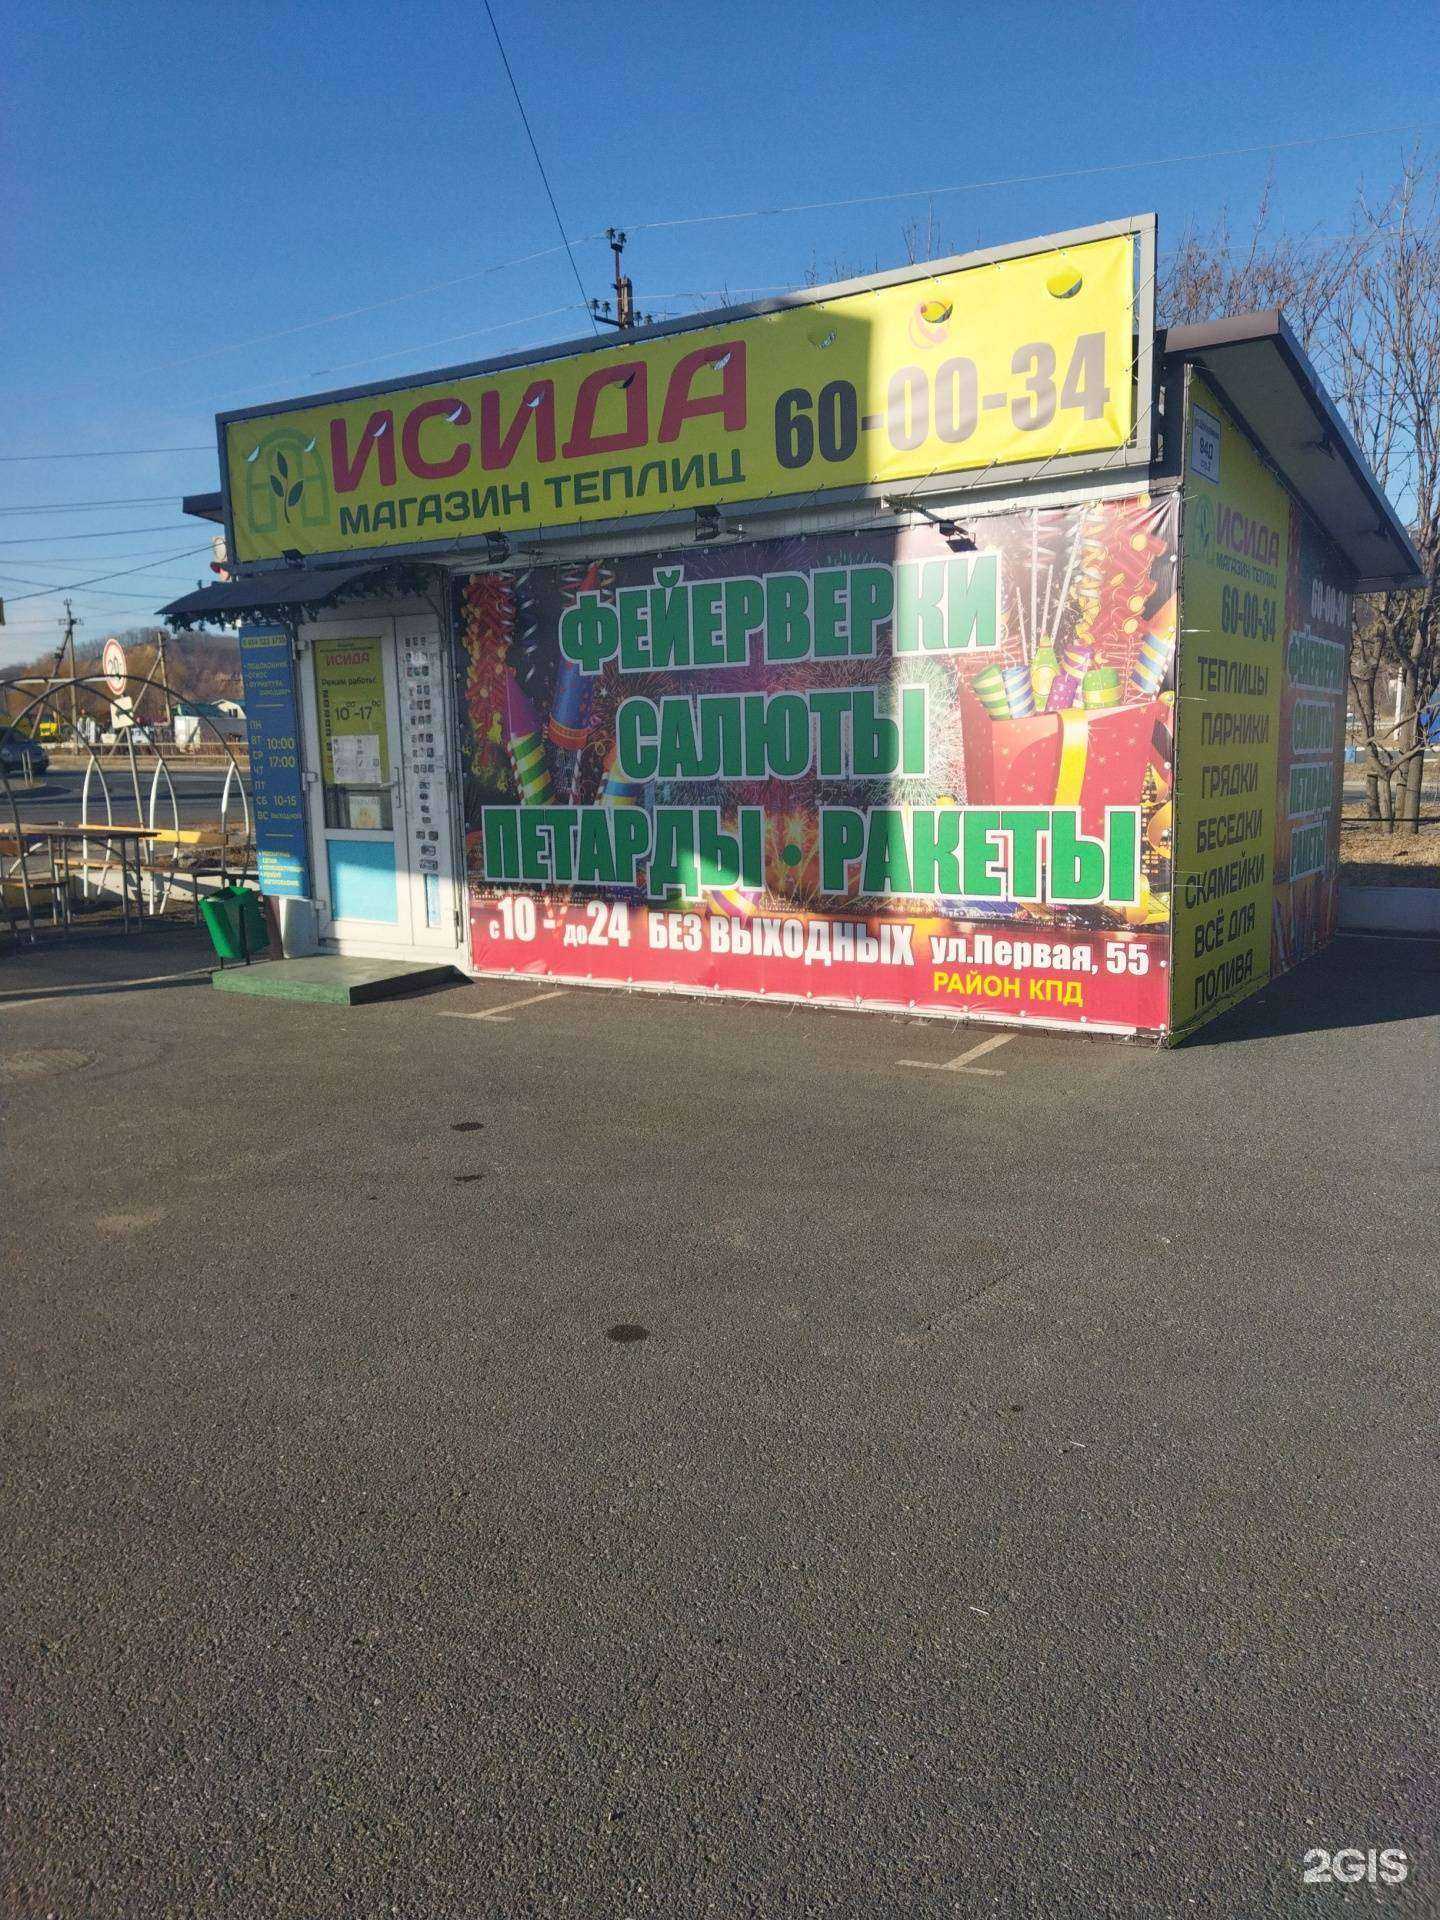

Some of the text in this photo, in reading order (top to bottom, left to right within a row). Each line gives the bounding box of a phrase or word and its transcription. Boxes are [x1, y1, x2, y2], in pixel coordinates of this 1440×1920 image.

[330, 340, 748, 493] ИСИДА
[775, 331, 1110, 470] 60-00-34
[339, 448, 747, 536] МАГАЗИН ТЕПЛИЦ
[1216, 501, 1280, 568] ИСИДА
[1216, 551, 1250, 581] МАГАЗИН
[558, 554, 1000, 675] ФЕЙЕРВЕРКИ
[1222, 584, 1276, 643] 60-00-34
[326, 651, 371, 666] ИСИДА
[1197, 656, 1269, 696] ТЕПЛИЦЫ
[266, 738, 295, 749] 10:00
[616, 684, 930, 781] САЛЮТЫ
[1201, 712, 1270, 746] ПАРНИКИ
[269, 756, 295, 768] 17:00
[1201, 763, 1259, 799] ГРЯДКИ
[481, 804, 1142, 907] ПЕТАРДЫ РАКЕТЫ
[1197, 809, 1263, 854] БЕСЕДКИ
[1184, 852, 1265, 909] СКАМЕЙКИ
[648, 912, 914, 966] БЕЗ ВЫХОДНЫХ
[1194, 902, 1256, 959] ВСЁ ДЛЯ
[1105, 942, 1150, 976] 55
[1194, 948, 1254, 1010] ПОЛИВА
[933, 969, 1084, 1007] РАЙОН КПД
